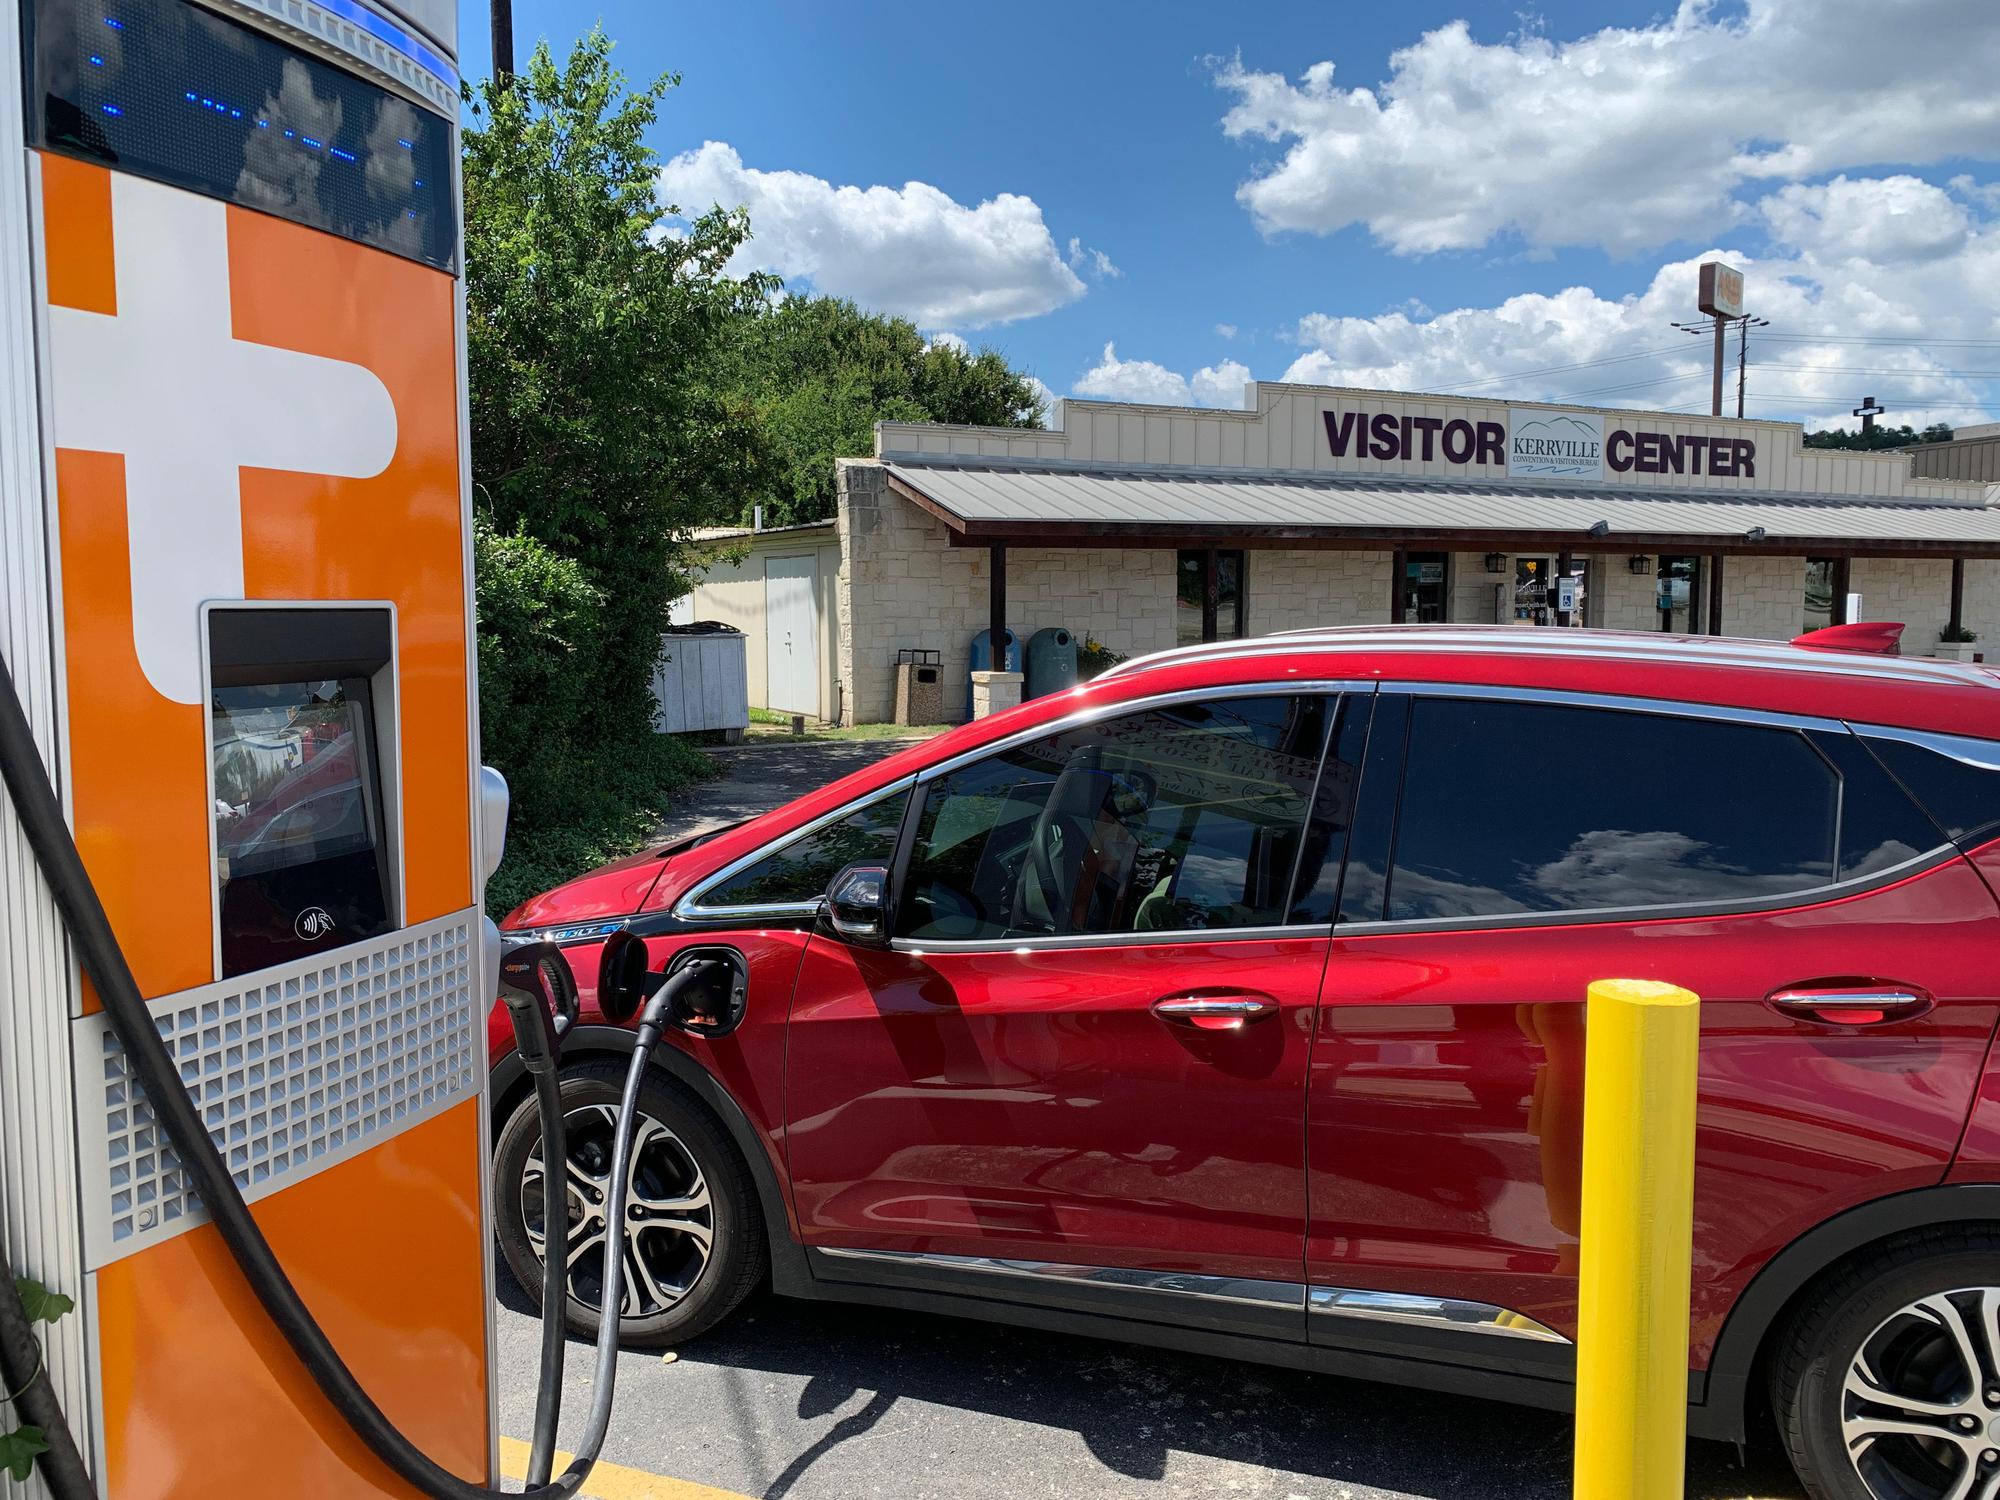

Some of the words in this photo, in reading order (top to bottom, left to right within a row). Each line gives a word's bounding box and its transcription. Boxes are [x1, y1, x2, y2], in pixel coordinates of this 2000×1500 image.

[1323, 411, 1505, 465] VISITOR
[1606, 430, 1755, 478] CENTER
[1514, 438, 1599, 458] KERRVILLE
[1513, 455, 1549, 464] CONVENTION
[555, 927, 598, 939] BOLT
